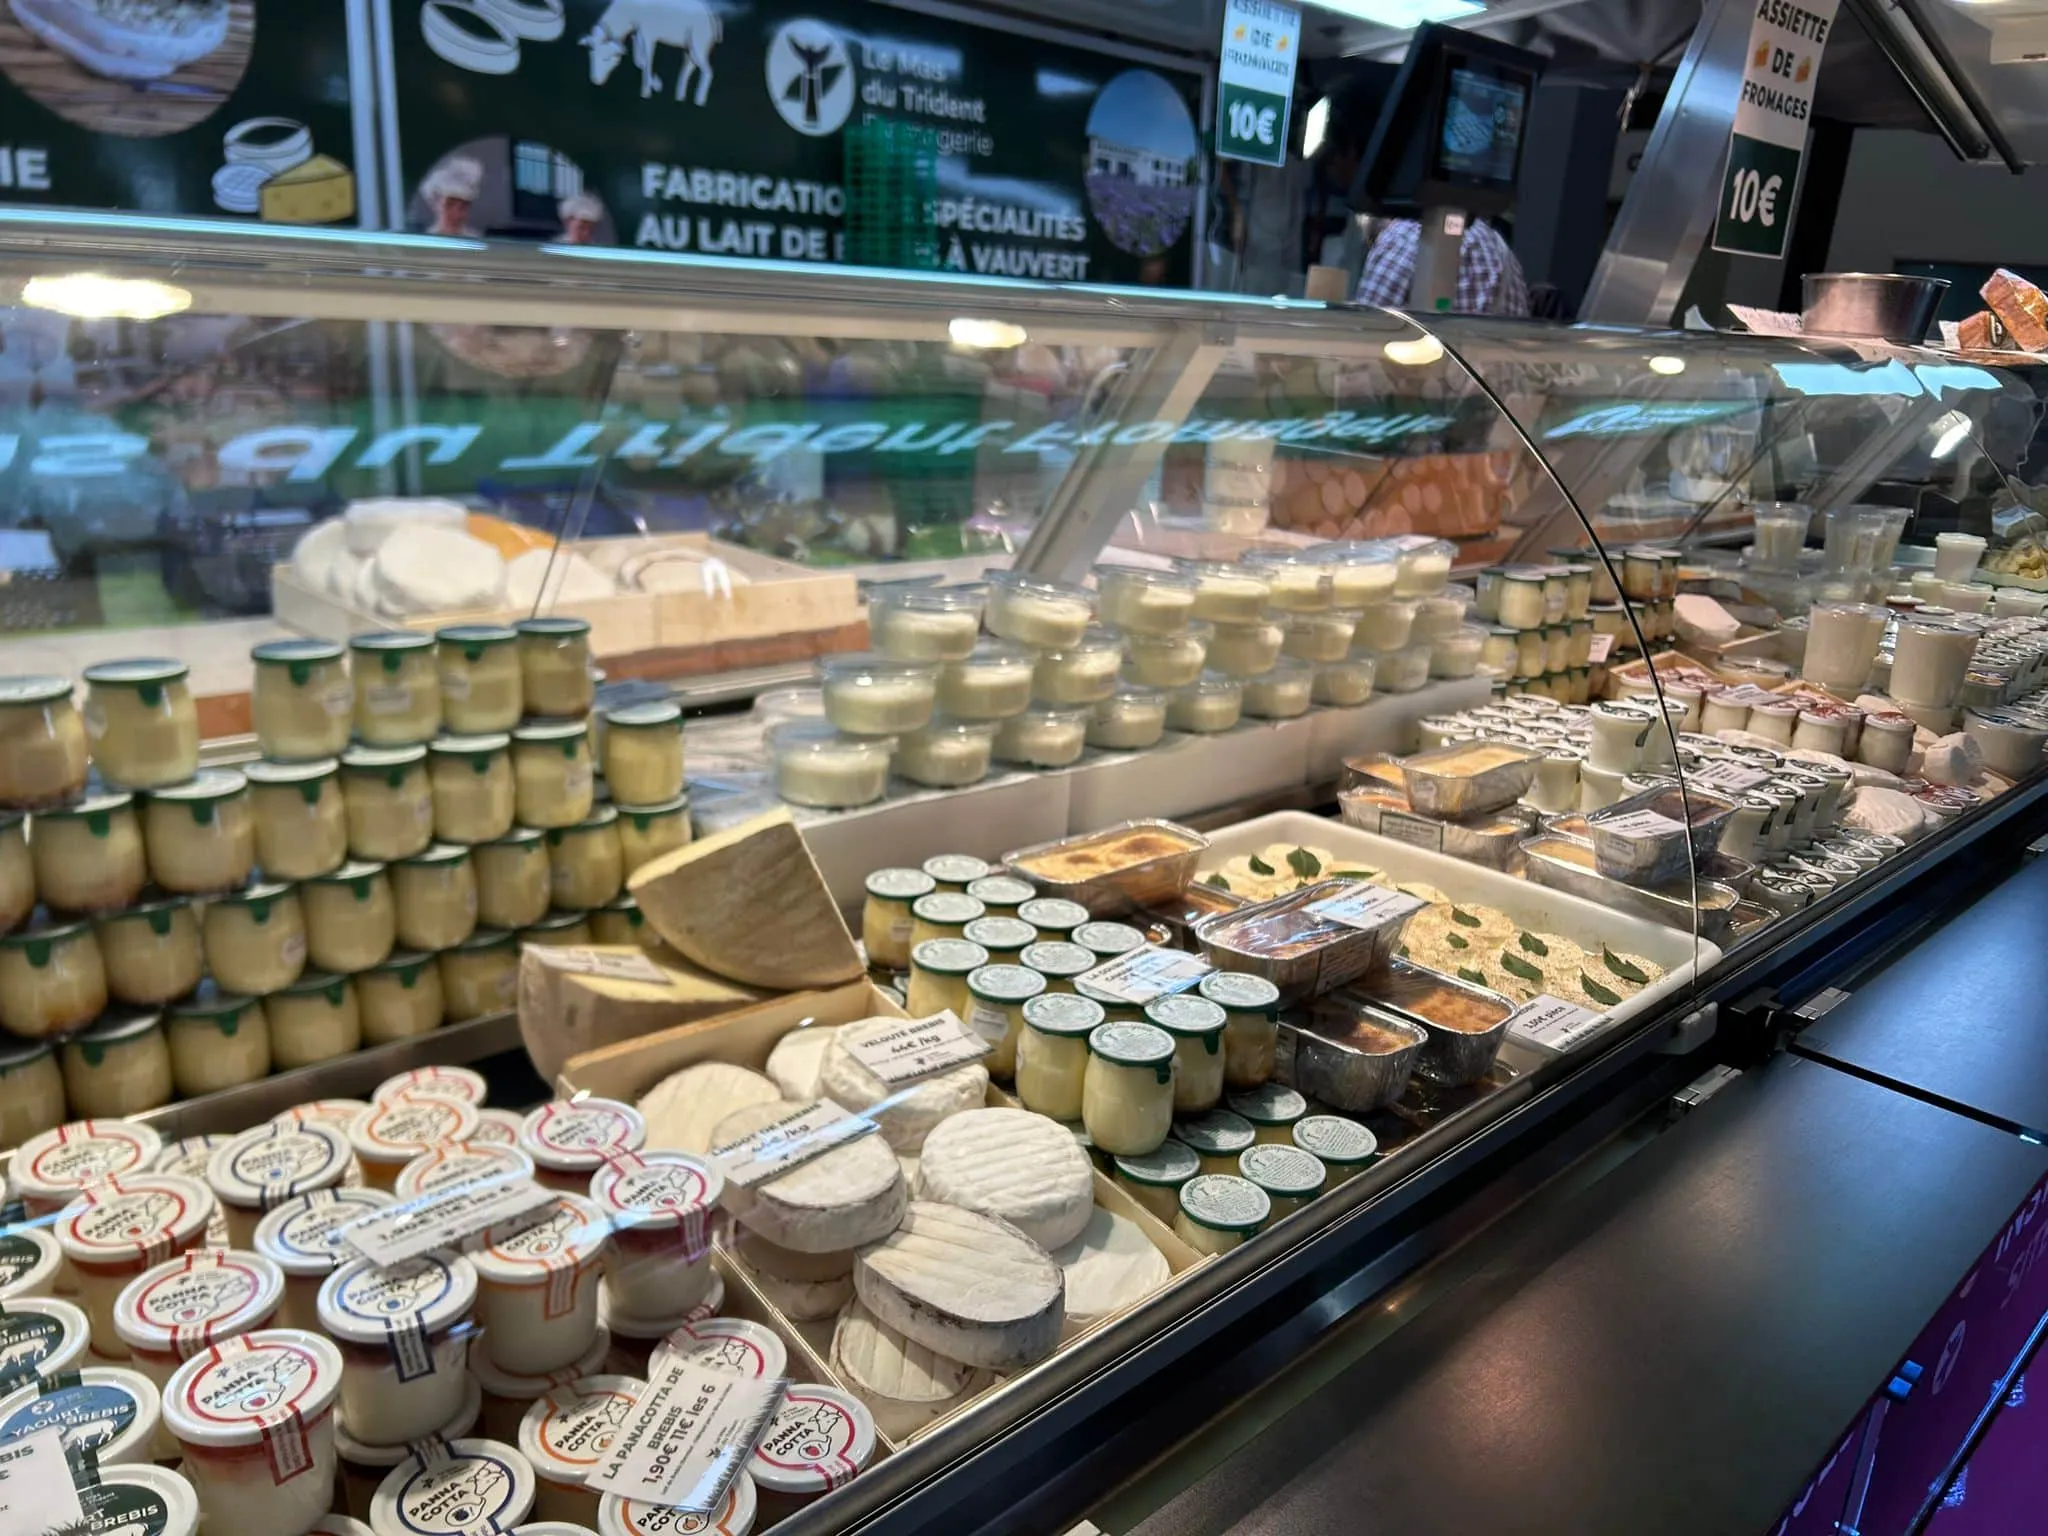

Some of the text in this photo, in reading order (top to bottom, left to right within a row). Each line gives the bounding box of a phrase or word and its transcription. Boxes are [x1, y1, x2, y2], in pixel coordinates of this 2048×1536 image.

[1757, 0, 1829, 43] ASSIETTE
[1772, 47, 1796, 78] DE
[861, 77, 987, 124] du Trident
[1742, 79, 1808, 120] FROMAGES
[1228, 99, 1277, 145] 10€
[641, 163, 845, 217] FABRICATIO
[1729, 168, 1783, 226] 10€
[635, 212, 691, 249] AU
[697, 216, 776, 256] LAIT
[781, 225, 828, 261] DE
[946, 233, 967, 272] À
[970, 242, 1090, 281] VAUVERT
[200, 1370, 259, 1406] PANNA
[11, 1406, 82, 1438] YAOURT
[65, 1403, 130, 1426] BREBIS
[555, 1414, 597, 1449] PANNA
[602, 1366, 685, 1480] LA PANACOTTA DE
[647, 1405, 683, 1451] BREBIS
[567, 1420, 607, 1453] COTTA
[641, 1444, 679, 1485] 1,90€
[669, 1418, 695, 1443] 11€
[685, 1397, 709, 1418] les
[701, 1383, 717, 1395] 6
[763, 1419, 806, 1453] PANNA
[775, 1427, 816, 1457] COTTA
[90, 1503, 159, 1531] BREBIS
[408, 1481, 462, 1518] PANNA
[420, 1489, 471, 1523] COTTA
[637, 1503, 668, 1528] PAN
[650, 1508, 677, 1532] COT
